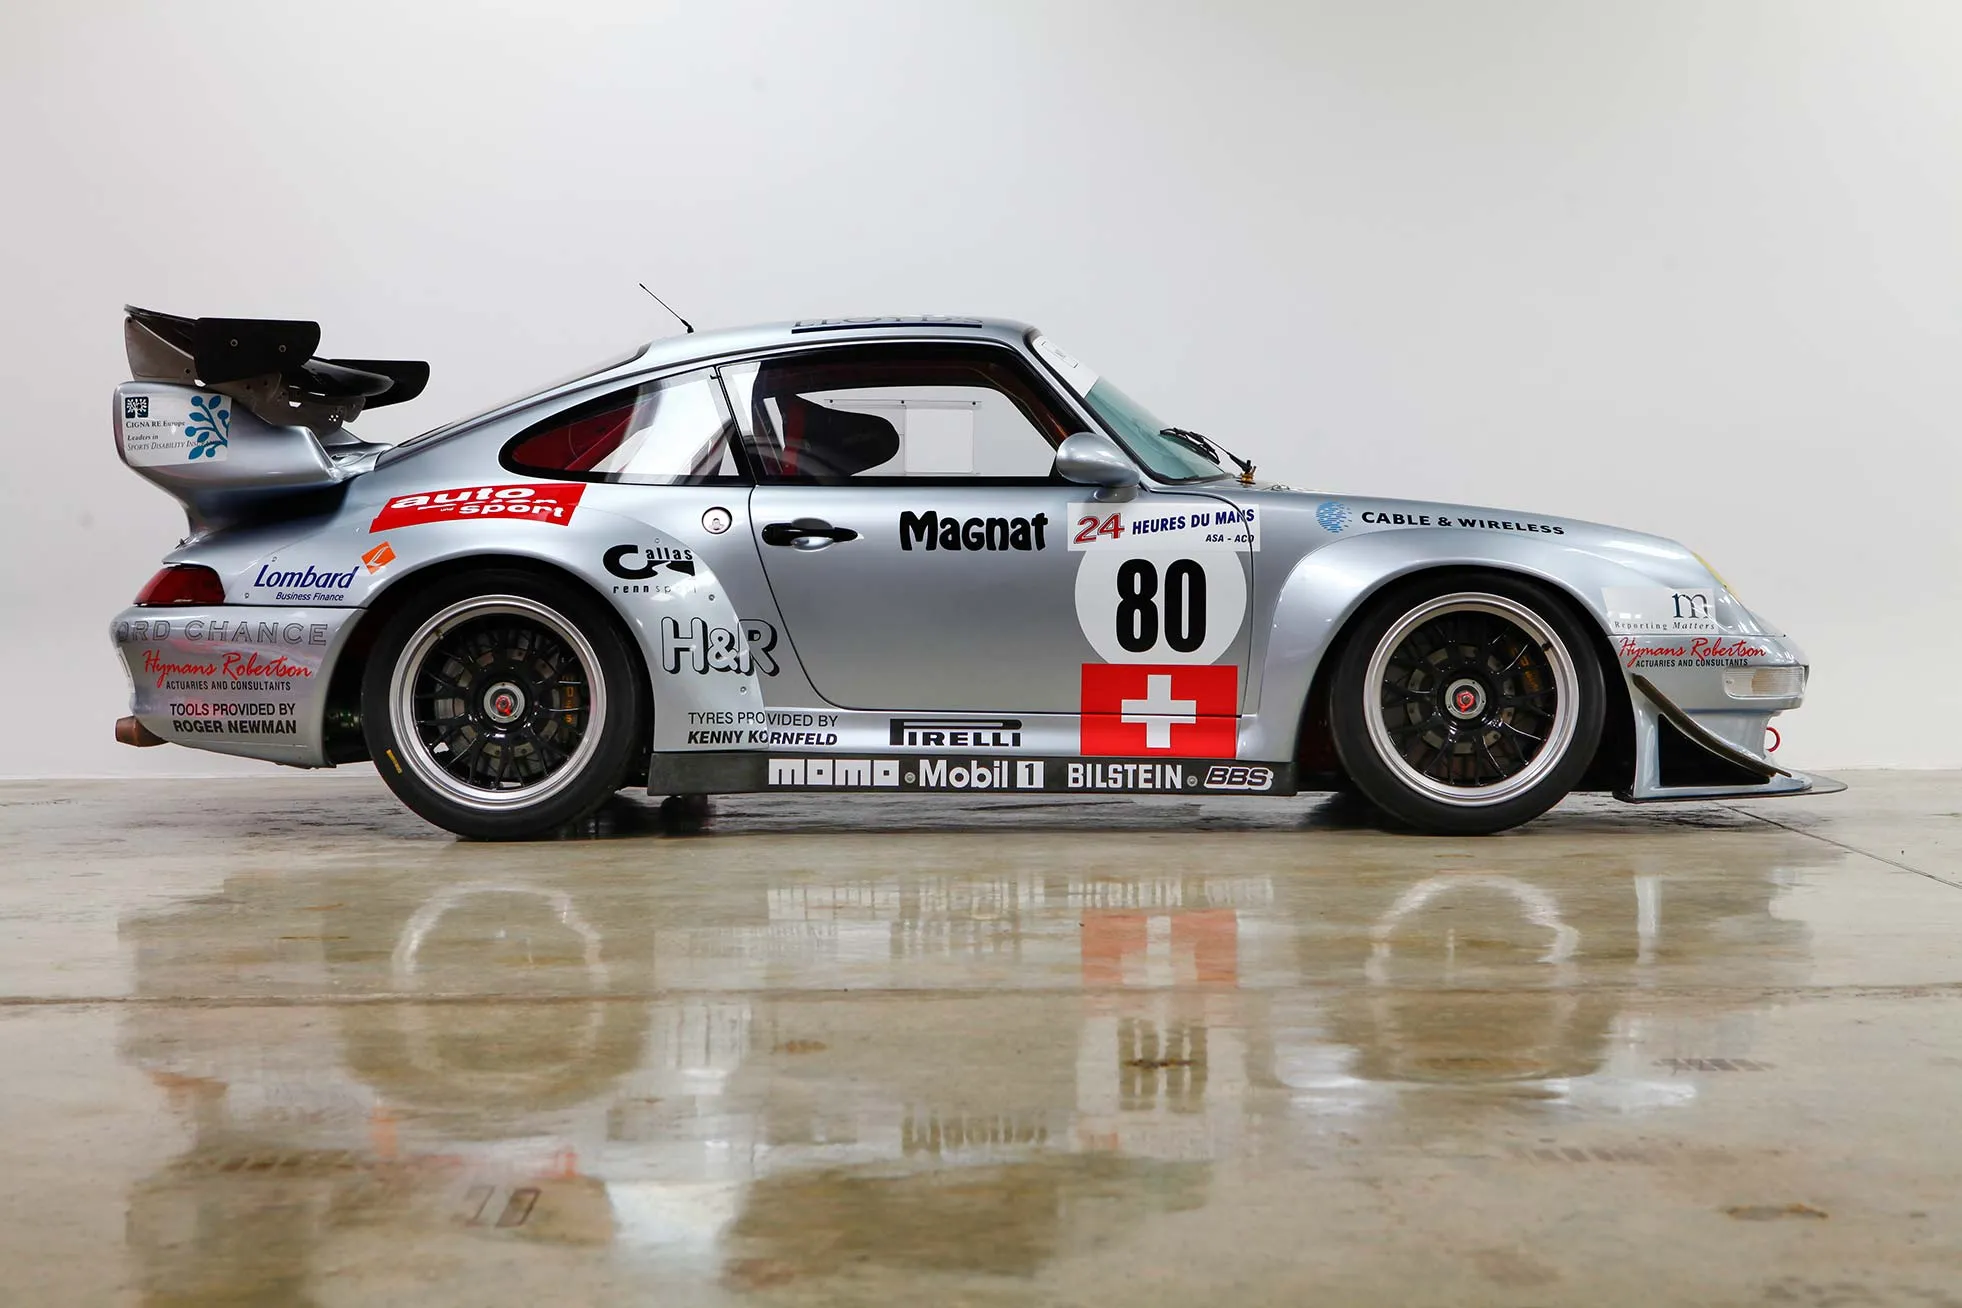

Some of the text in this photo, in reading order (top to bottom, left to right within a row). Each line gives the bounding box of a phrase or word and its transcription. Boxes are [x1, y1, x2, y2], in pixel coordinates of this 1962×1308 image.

[163, 420, 186, 428] Europe
[127, 433, 151, 441] Leaders
[127, 443, 149, 451] SPORTS
[151, 441, 186, 450] DISABILITY
[390, 487, 535, 509] auto
[458, 504, 565, 518] sport
[900, 511, 1048, 551] Magnat
[1073, 508, 1255, 544] 24 HEURES DU MANS
[1361, 511, 1565, 535] CABLE & WIRELESS
[1205, 534, 1224, 543] ASA
[1234, 534, 1255, 544] ACO
[254, 564, 360, 589] Lombard
[276, 592, 344, 602] Business Finance
[1116, 558, 1207, 653] 80
[114, 619, 329, 646] ORD CHANCE
[1615, 621, 1715, 631] Reporting Matters
[661, 616, 780, 677] H&R
[1619, 636, 1767, 668] Hymans Robertson
[142, 649, 312, 689] Hymans Robertson
[1635, 658, 1748, 668] ACTUARIES AND CONSULTANTS
[166, 680, 291, 691] ACTUARIES AND CONSULTANTS
[170, 703, 296, 716] TOOLS PROVIDED BY
[688, 712, 838, 728] TYRES PROVIDED BY
[173, 720, 297, 734] ROGER NEWMAN
[688, 730, 838, 746] KENNY KORNFELD
[889, 718, 1023, 747] PIRELLI
[919, 759, 1008, 789] Mobil
[1068, 763, 1182, 789] BILSTEIN
[1203, 766, 1274, 791] BBS
